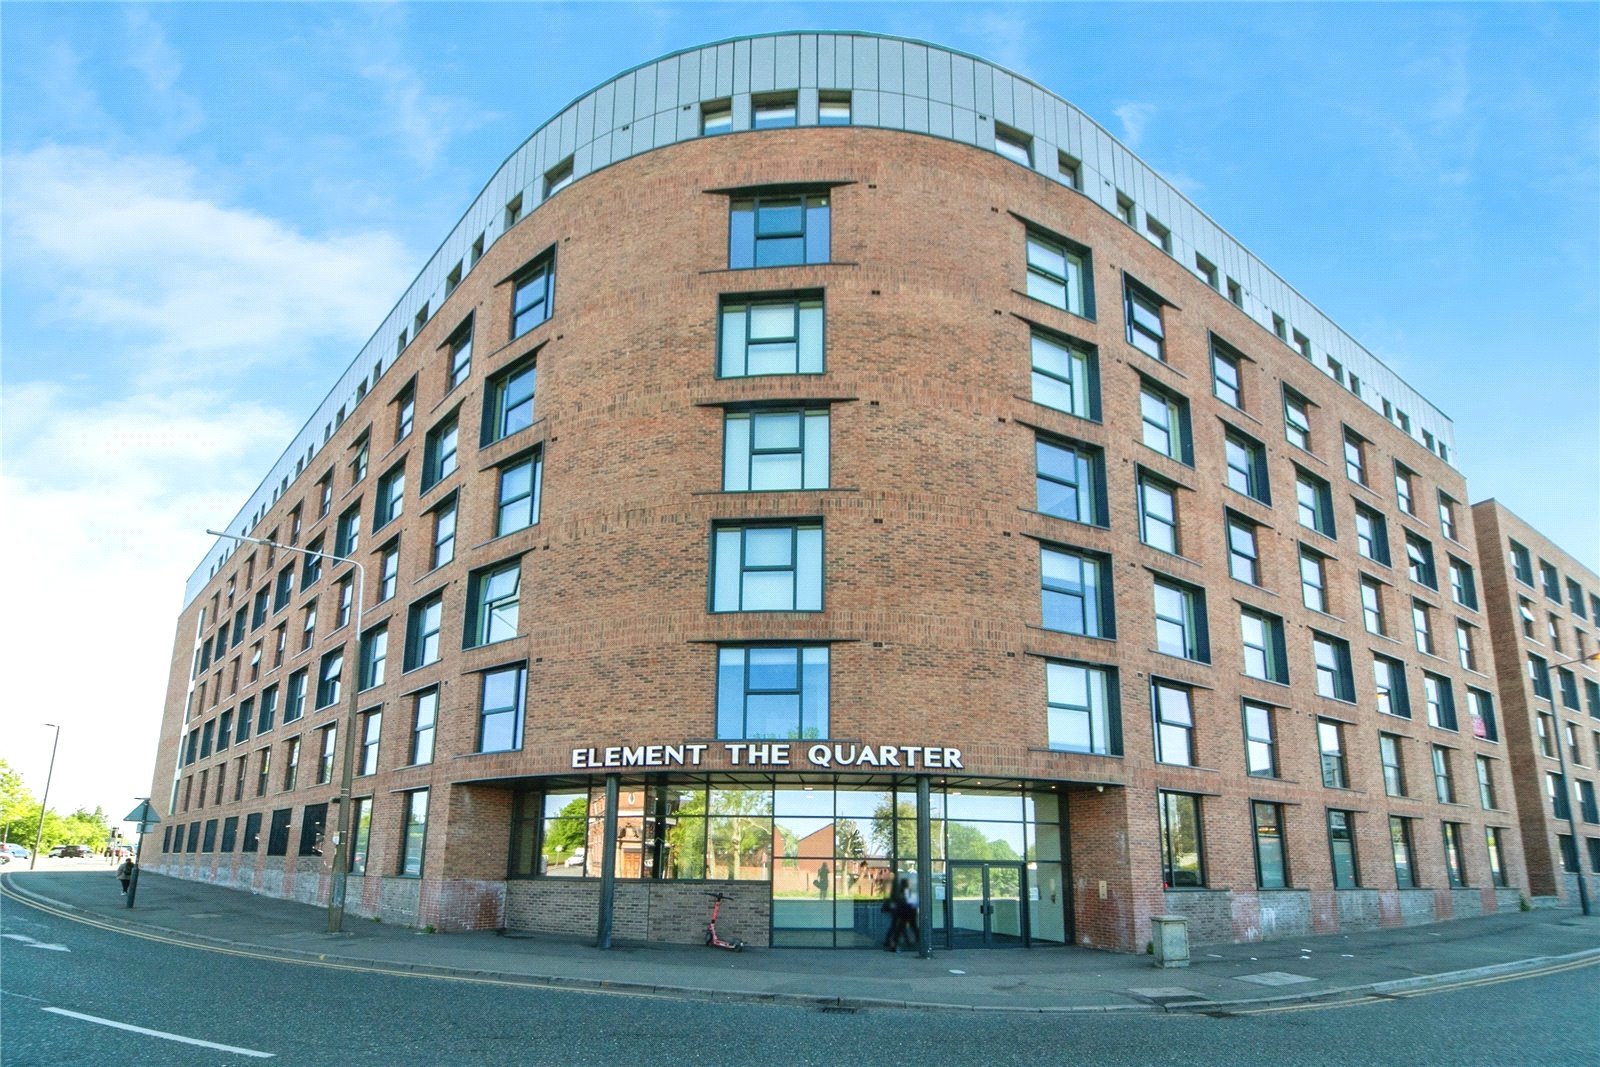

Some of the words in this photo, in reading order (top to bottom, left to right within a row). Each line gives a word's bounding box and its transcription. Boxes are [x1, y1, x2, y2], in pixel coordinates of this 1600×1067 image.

[571, 744, 708, 768] ELEMENT
[724, 744, 790, 765] THE
[807, 744, 964, 769] QUARTER
